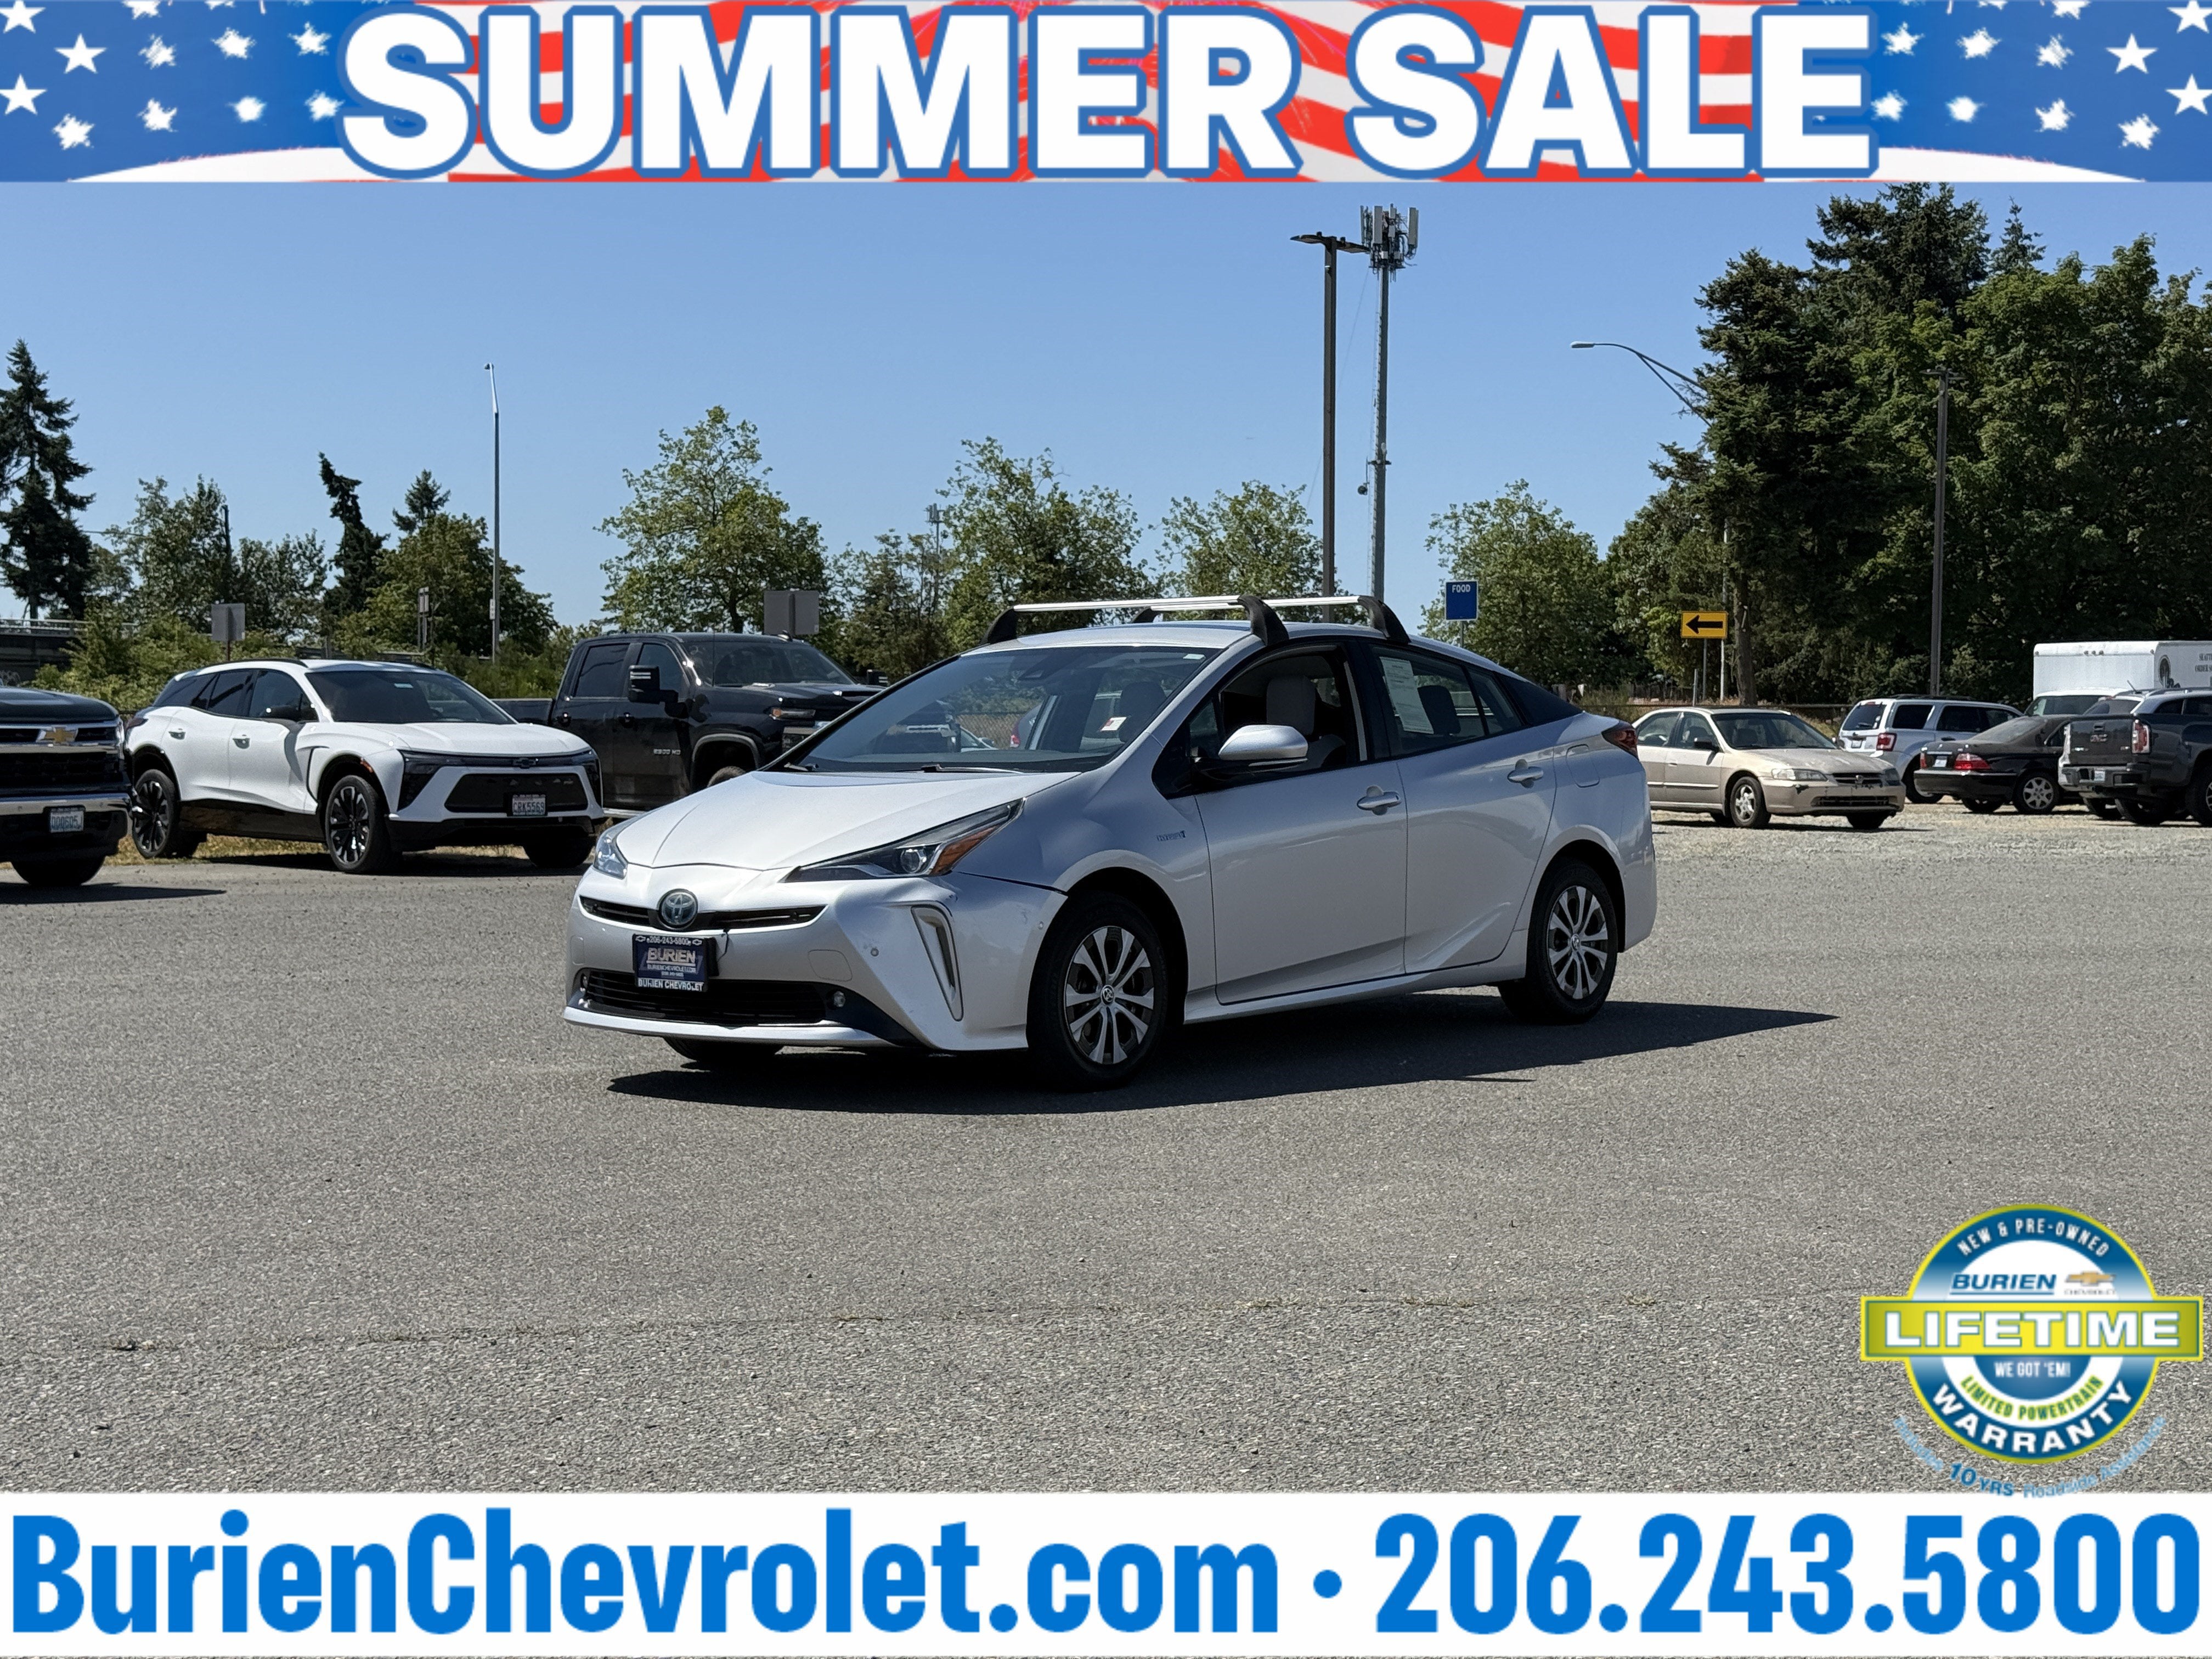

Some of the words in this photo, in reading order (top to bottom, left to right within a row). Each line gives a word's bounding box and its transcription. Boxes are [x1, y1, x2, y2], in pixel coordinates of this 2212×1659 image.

[1452, 584, 1471, 593] FOOD
[648, 947, 696, 963] BURIEN
[638, 978, 663, 988] BURIEN
[665, 980, 704, 992] CHEVROLET
